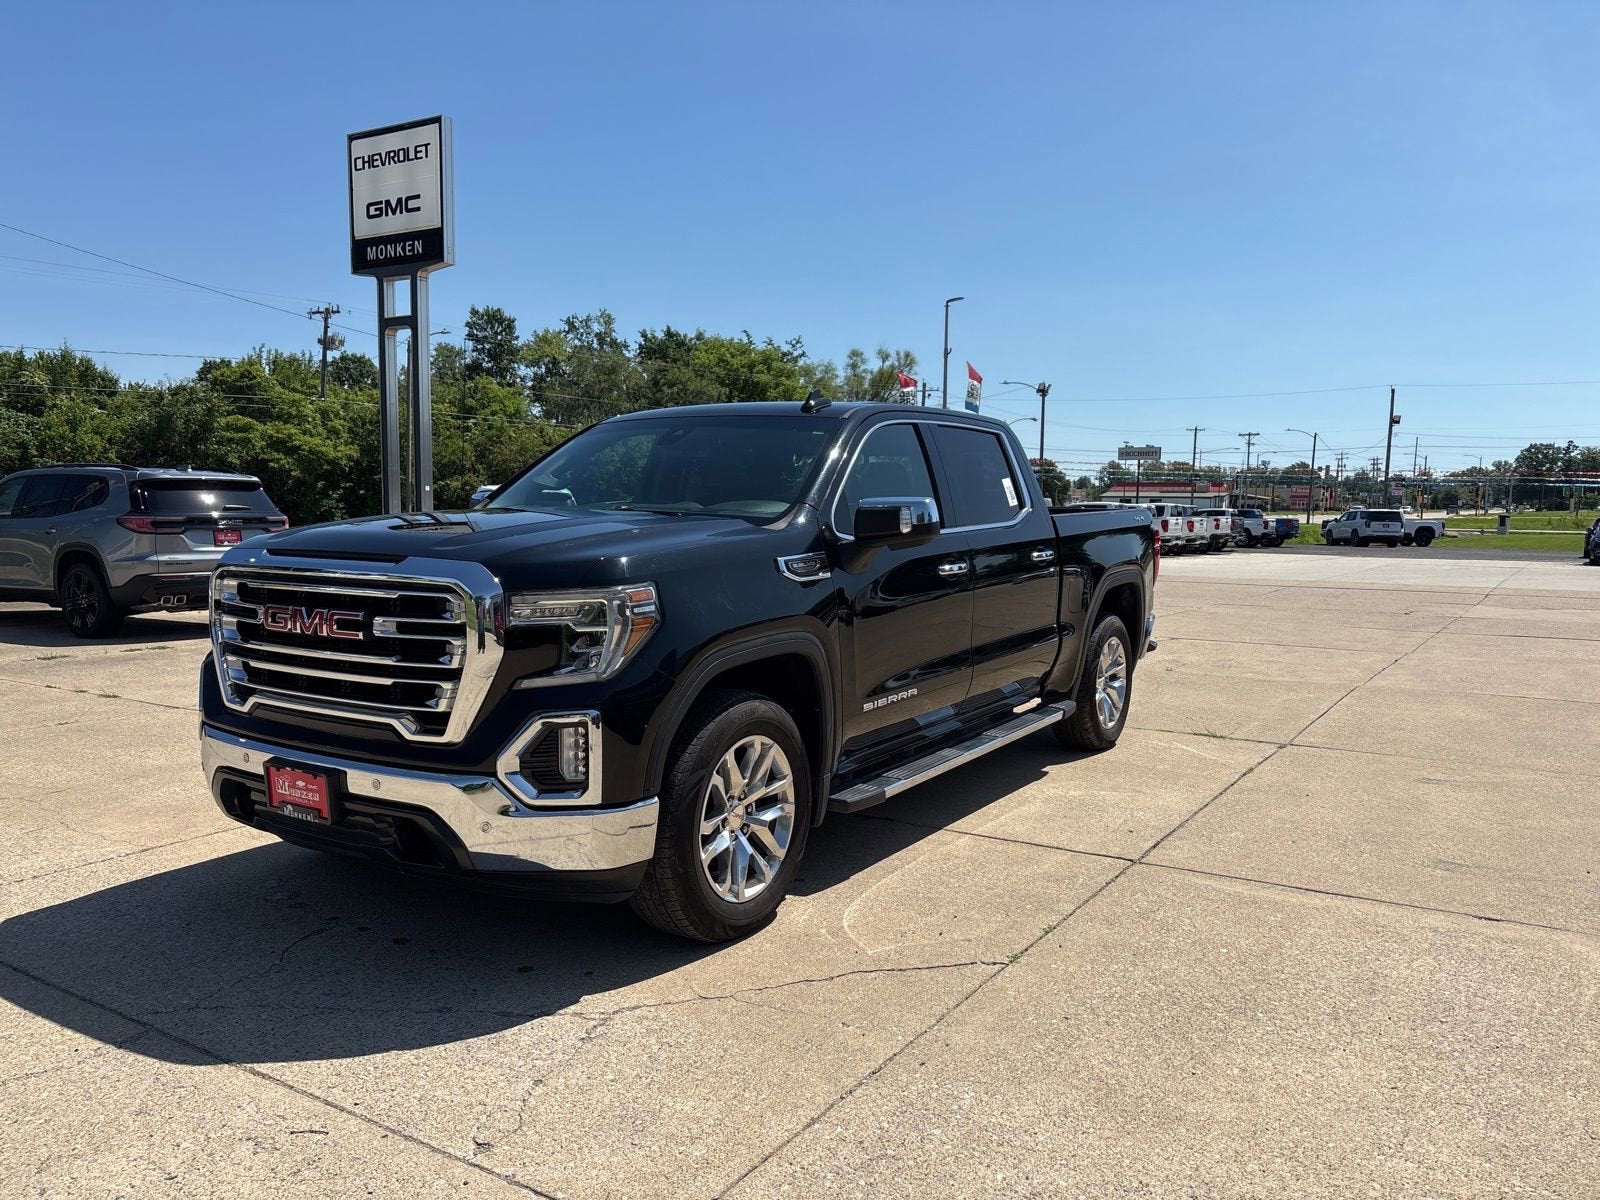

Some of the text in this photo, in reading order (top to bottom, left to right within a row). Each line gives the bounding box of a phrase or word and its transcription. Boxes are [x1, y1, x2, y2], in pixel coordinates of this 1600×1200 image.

[353, 142, 431, 172] CHEVROLET
[365, 193, 421, 220] GMC
[366, 239, 423, 261] MONKEN
[263, 603, 364, 640] GMC
[862, 688, 918, 712] SIERRA
